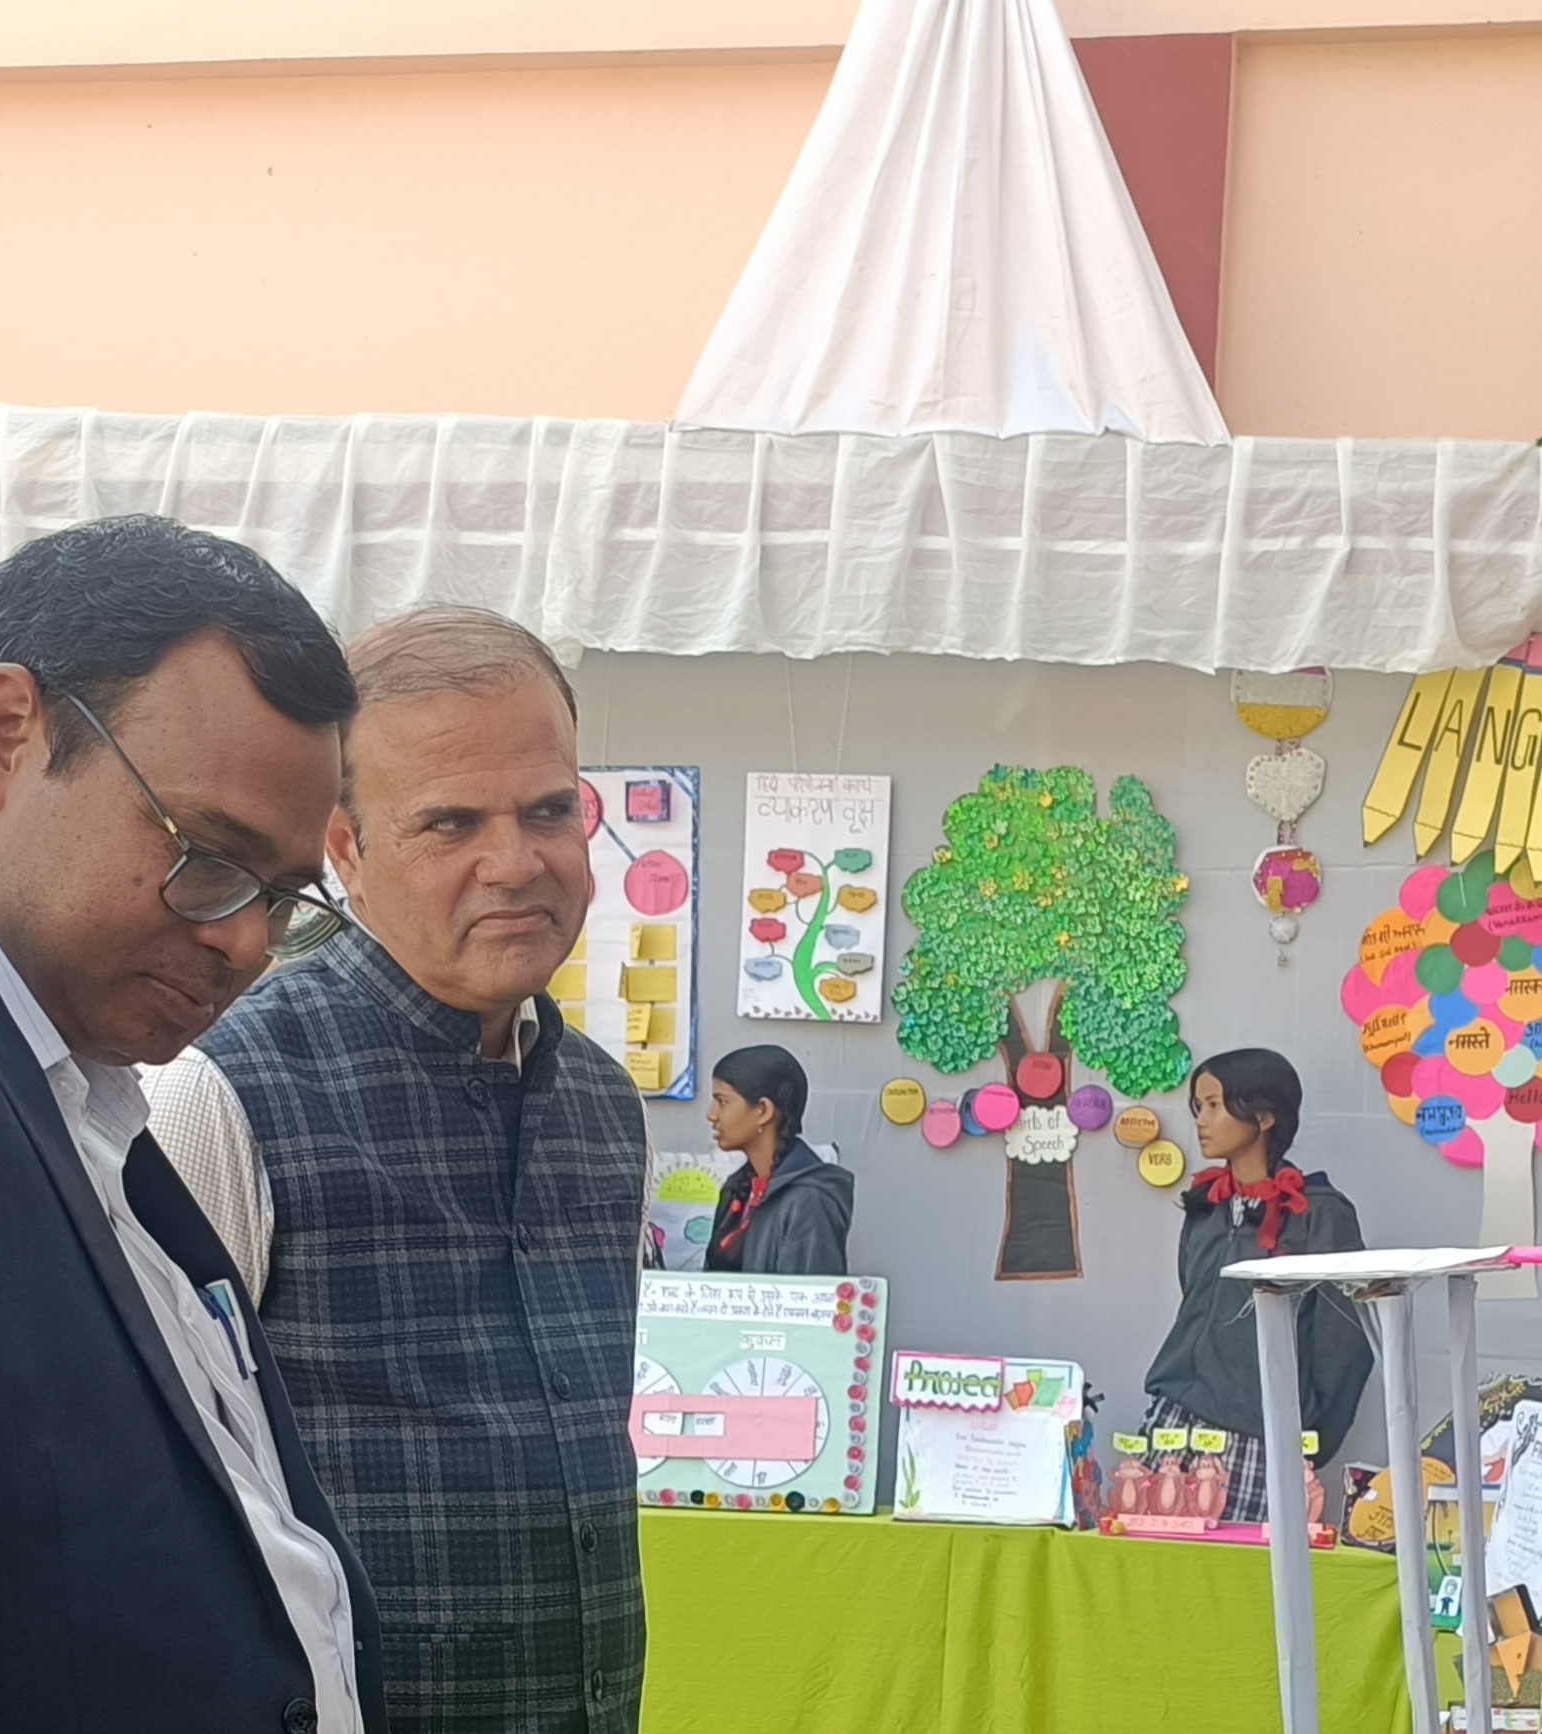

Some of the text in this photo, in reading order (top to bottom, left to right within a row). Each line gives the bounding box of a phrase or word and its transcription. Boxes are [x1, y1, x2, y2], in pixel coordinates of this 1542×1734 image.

[1449, 1027, 1491, 1050] नमस्ते
[1047, 1109, 1062, 1130] of
[1022, 1134, 1065, 1158] Speech
[1148, 1152, 1173, 1167] VERB
[741, 1333, 785, 1349] बहुवचन
